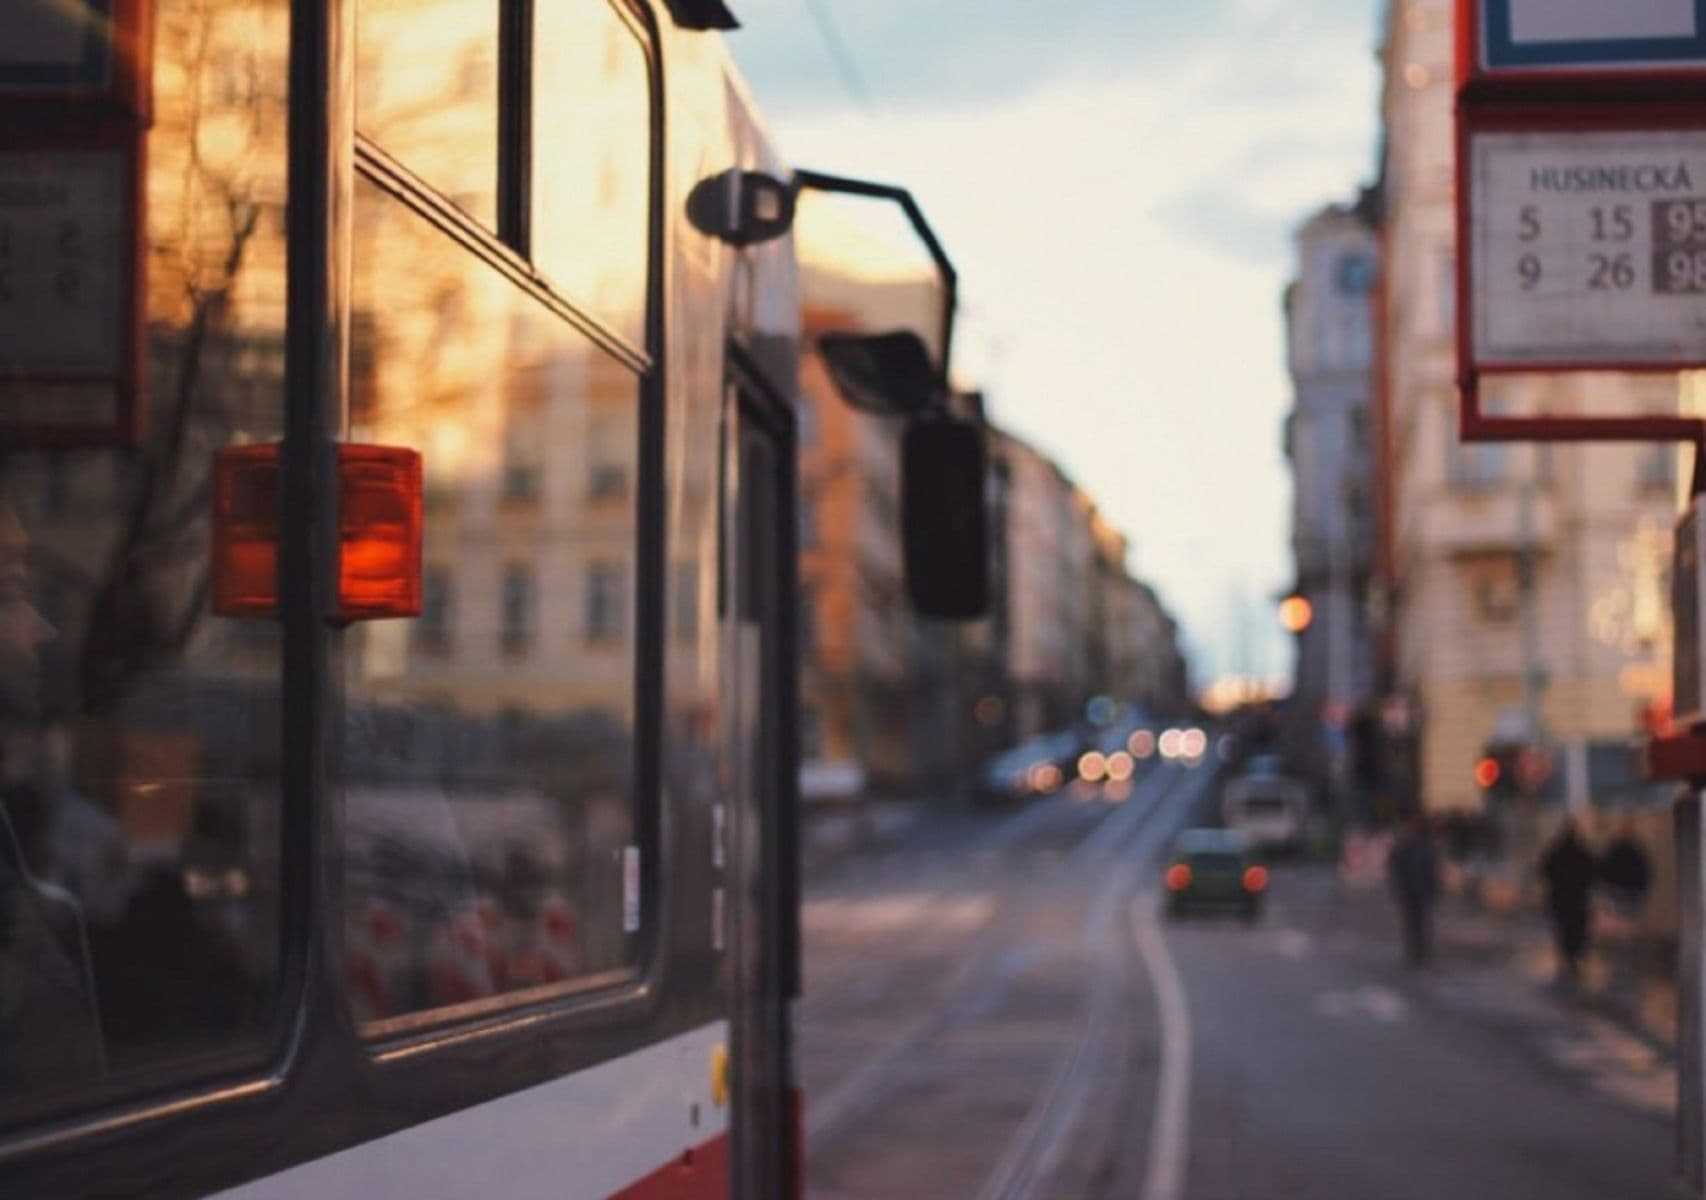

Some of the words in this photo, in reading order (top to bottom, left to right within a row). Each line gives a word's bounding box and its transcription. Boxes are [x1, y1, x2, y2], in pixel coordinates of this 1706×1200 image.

[1530, 161, 1692, 192] HUSINECKÁ
[1518, 206, 1541, 241] 5
[1590, 206, 1632, 240] 15
[1518, 254, 1541, 290] 9
[1588, 254, 1634, 289] 26
